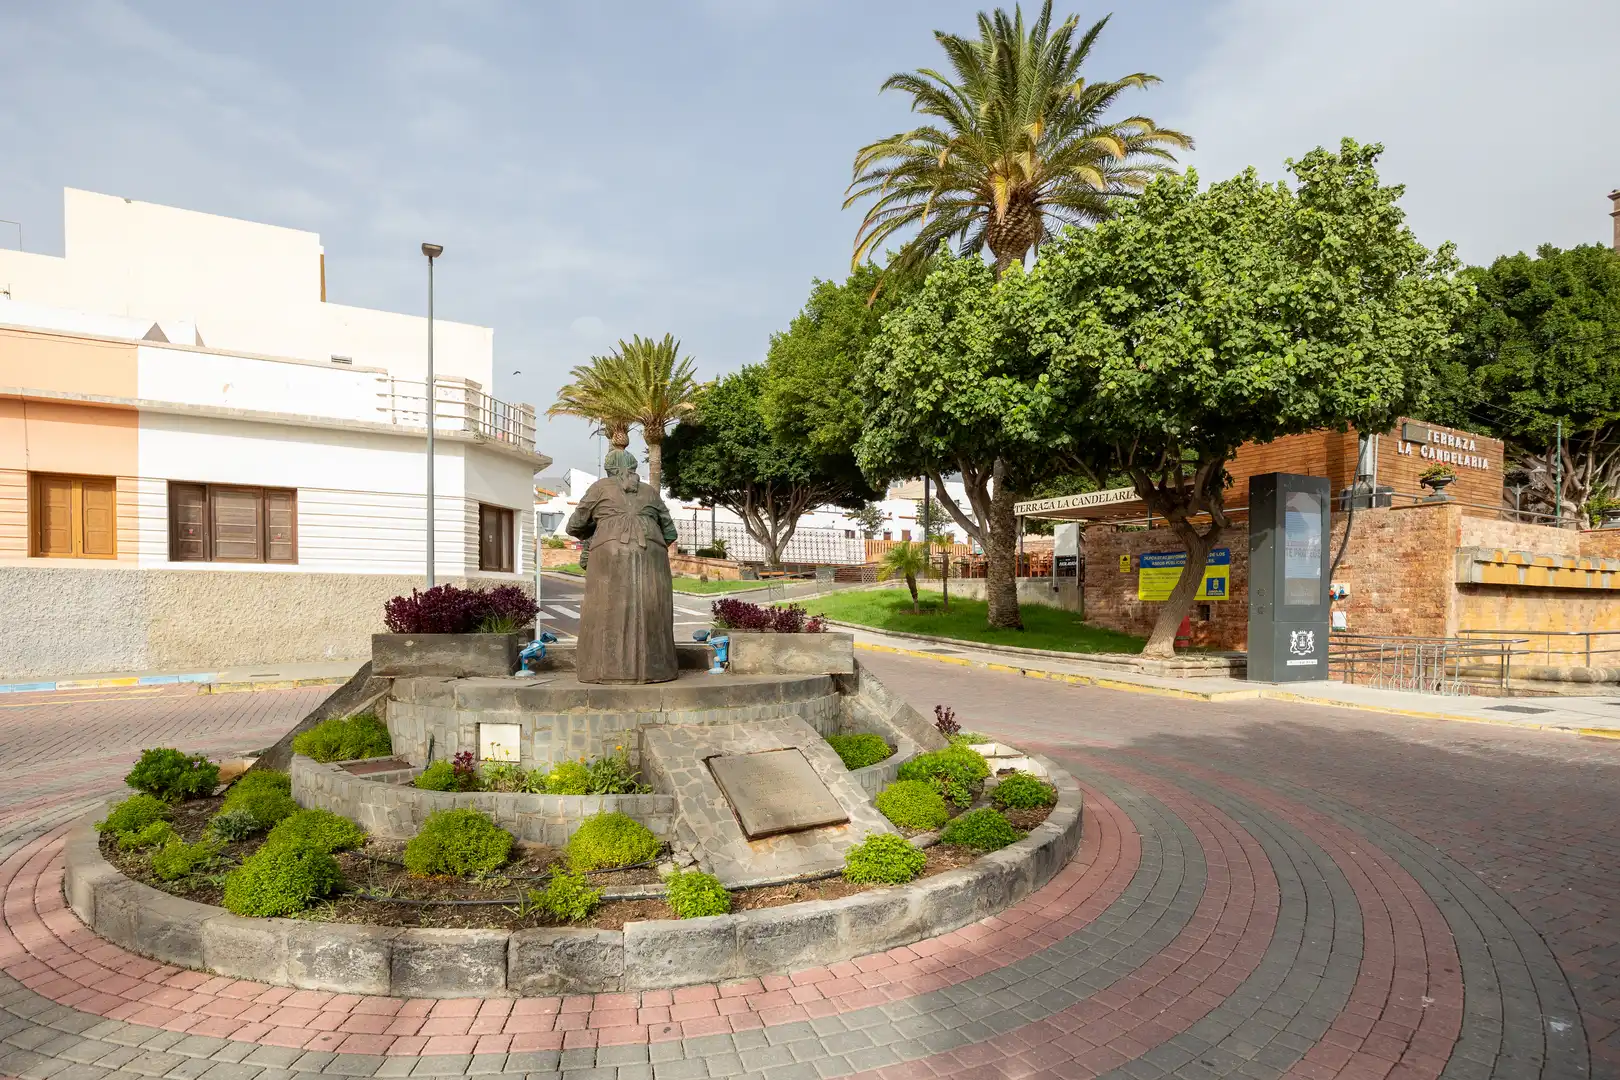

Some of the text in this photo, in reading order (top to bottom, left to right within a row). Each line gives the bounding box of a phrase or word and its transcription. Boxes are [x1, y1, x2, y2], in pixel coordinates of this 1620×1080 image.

[1427, 430, 1476, 452] TERRAZA
[1397, 440, 1489, 470] LA CANDELARIA
[1014, 491, 1137, 514] TERRAZA LA CANDELARIA
